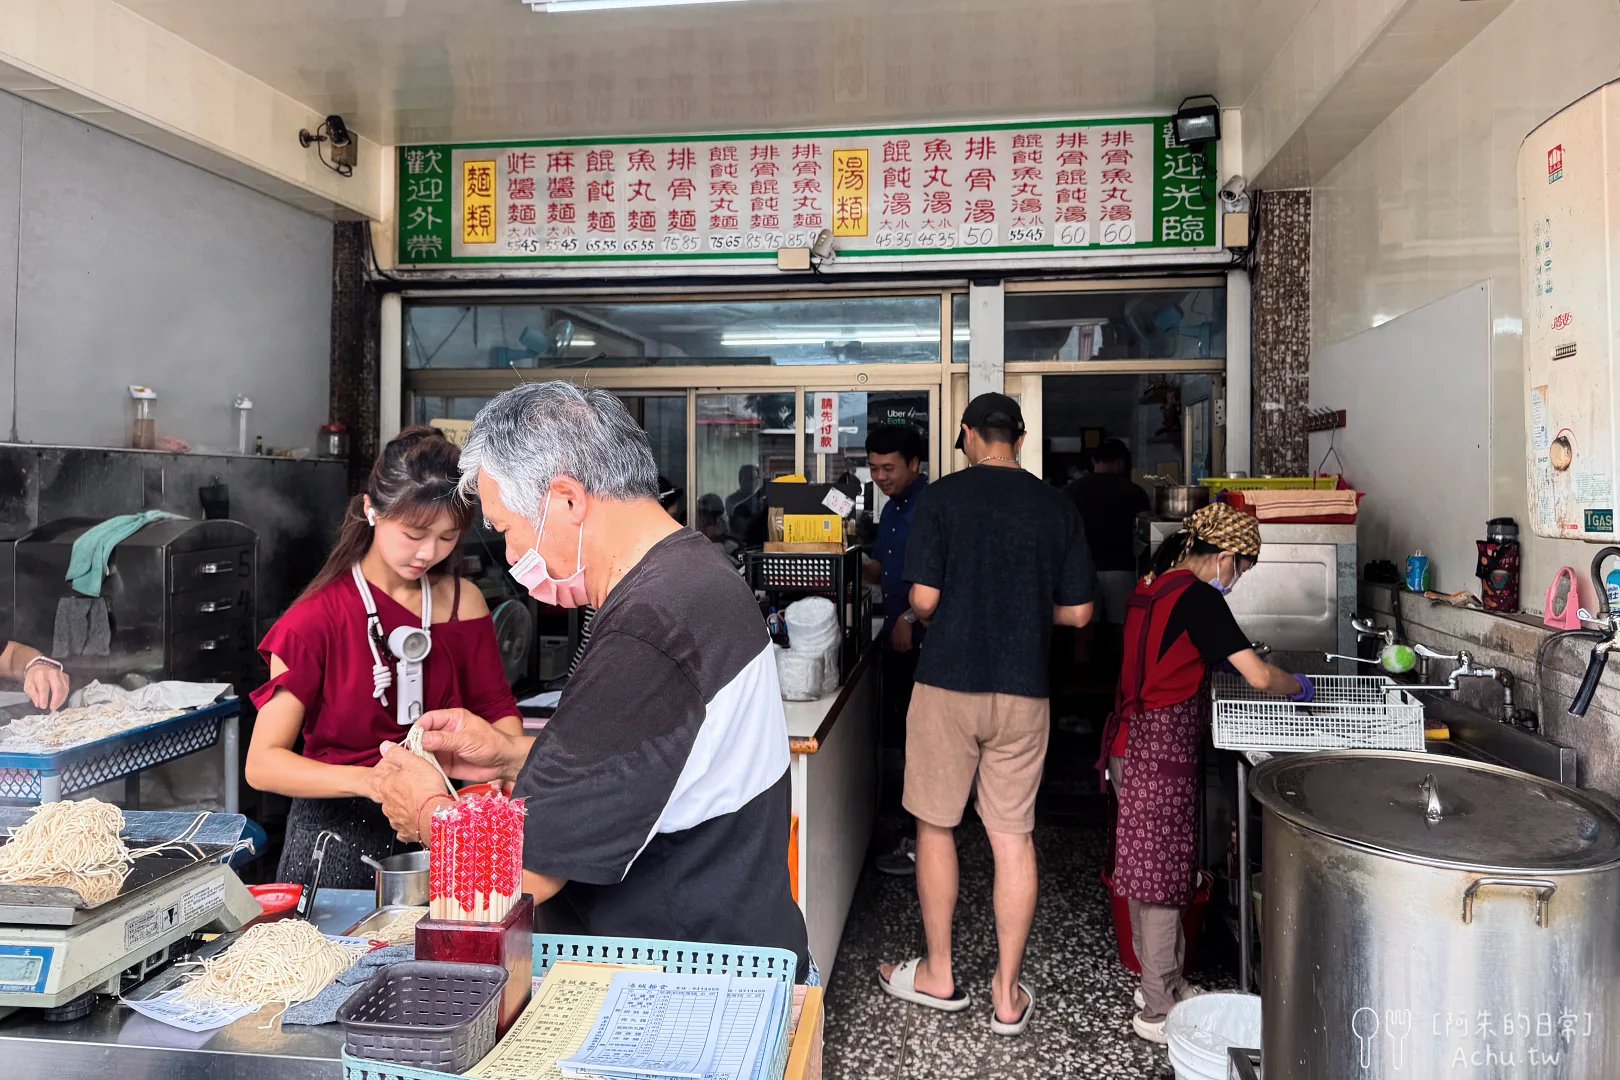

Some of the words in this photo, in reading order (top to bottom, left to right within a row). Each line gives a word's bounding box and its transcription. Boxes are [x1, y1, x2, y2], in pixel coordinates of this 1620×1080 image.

[407, 149, 443, 258] 歡迎外帶
[466, 166, 491, 237] 麵類
[507, 151, 536, 225] 炸醬麵
[546, 151, 575, 224] 麻醬麵
[586, 150, 615, 233] 餛飩麵
[627, 148, 656, 232] 魚丸麵
[667, 147, 697, 231] 排骨麵
[708, 146, 738, 229] 餛飩魚丸麵
[750, 144, 780, 229] 排骨餛飩麵
[792, 143, 822, 228] 排骨魚丸麵
[836, 157, 864, 229] 湯類
[882, 140, 912, 215] 餛飩湯
[922, 138, 953, 214] 魚丸湯
[964, 136, 997, 223] 排骨湯
[1011, 133, 1043, 213] 餛飩魚丸湯
[1055, 132, 1088, 223] 排骨餛飩湯
[1100, 130, 1134, 221] 排骨魚丸湯
[967, 228, 993, 246] 50
[1061, 226, 1086, 244] 60
[1104, 225, 1132, 243] 60
[820, 398, 833, 448] 請先付款
[887, 410, 906, 418] Uber
[237, 589, 254, 613] 4
[238, 549, 251, 578] 5
